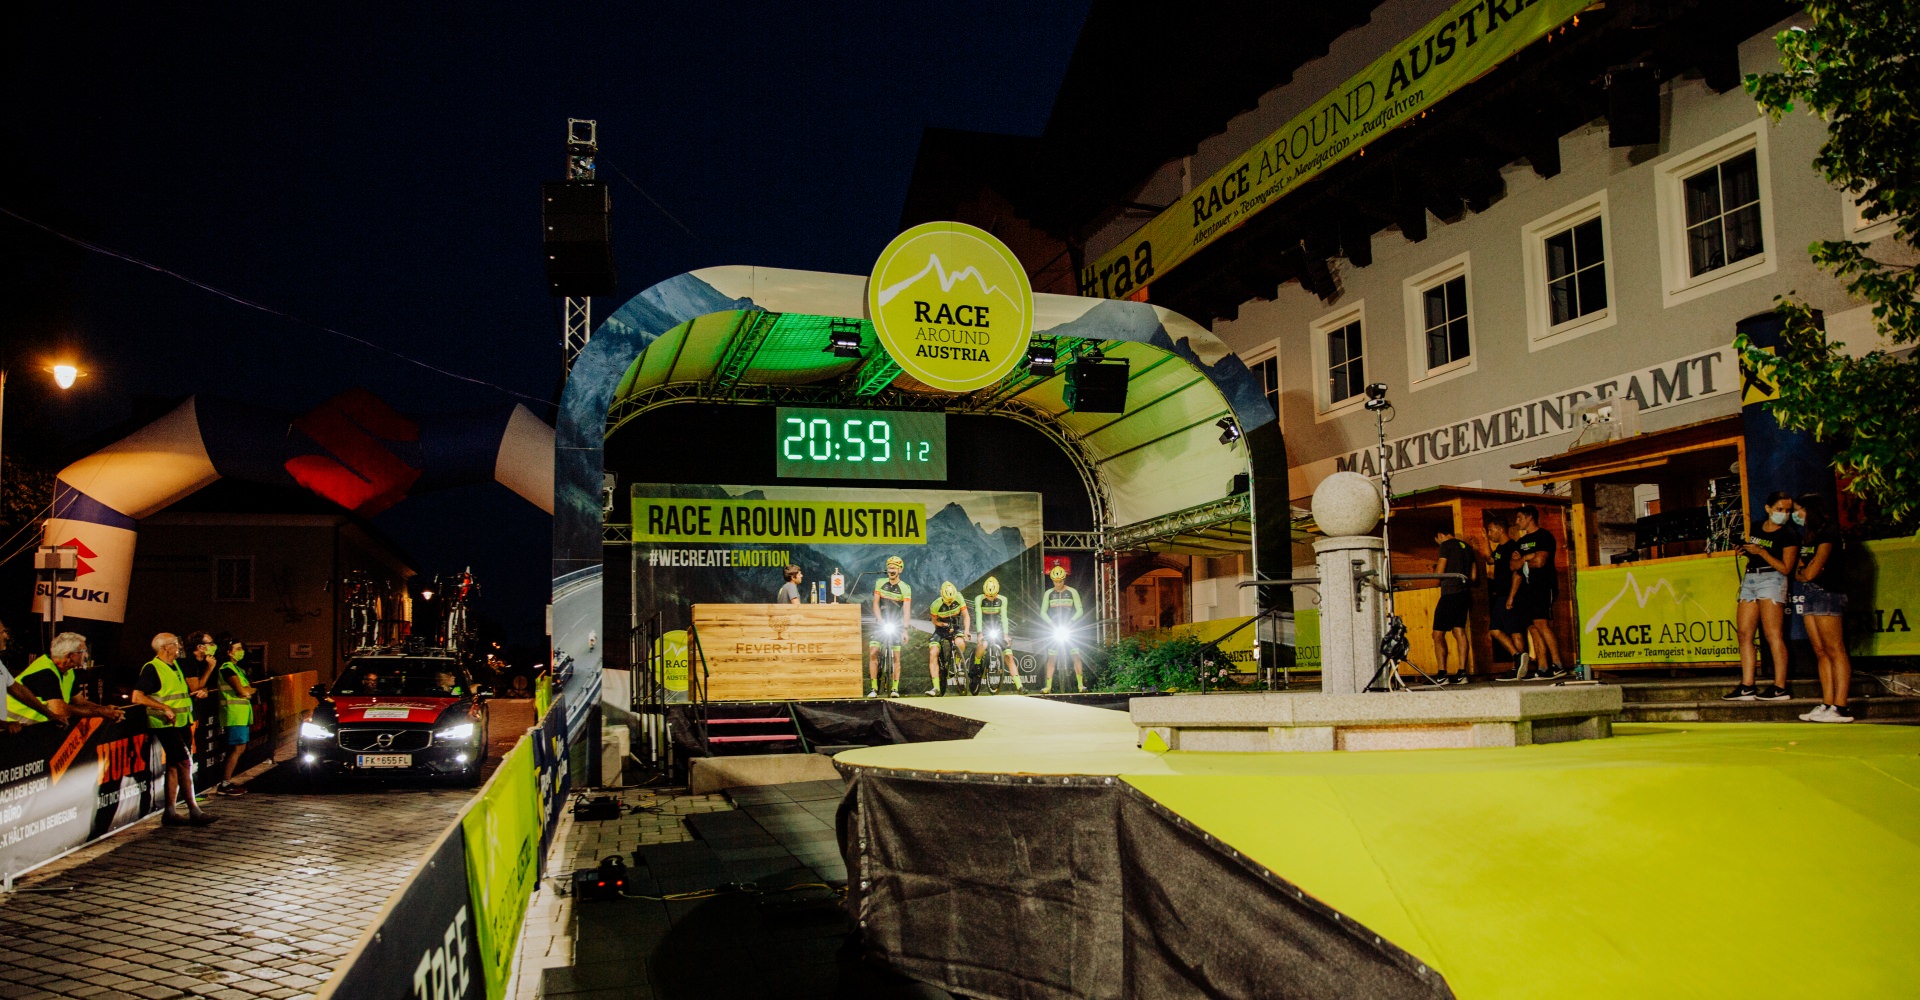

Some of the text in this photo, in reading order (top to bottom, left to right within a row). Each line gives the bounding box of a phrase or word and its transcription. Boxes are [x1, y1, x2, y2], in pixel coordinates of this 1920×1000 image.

[1192, 0, 1542, 228] RACE AROUND AUSTR
[1193, 212, 1231, 246] Abenteuer
[1293, 136, 1350, 179] Navigation
[1360, 90, 1424, 137] Radfahren
[1080, 240, 1154, 299] #raa
[914, 301, 990, 328] RACE
[915, 327, 990, 345] AROUND
[916, 344, 990, 362] AUSTRIA
[784, 418, 929, 462] 20:59 12
[648, 504, 920, 538] RACE AROUND AUSTRIA
[649, 549, 790, 567] #WECREATEEMOTION
[36, 584, 109, 603] SUZUKI
[1597, 620, 1740, 646] RACE AROUN
[1598, 645, 1740, 660] Abenteuer Teamgeist Navigatio
[665, 659, 688, 668] RAC
[25, 759, 44, 777] SPORT
[29, 776, 48, 795] SPORT
